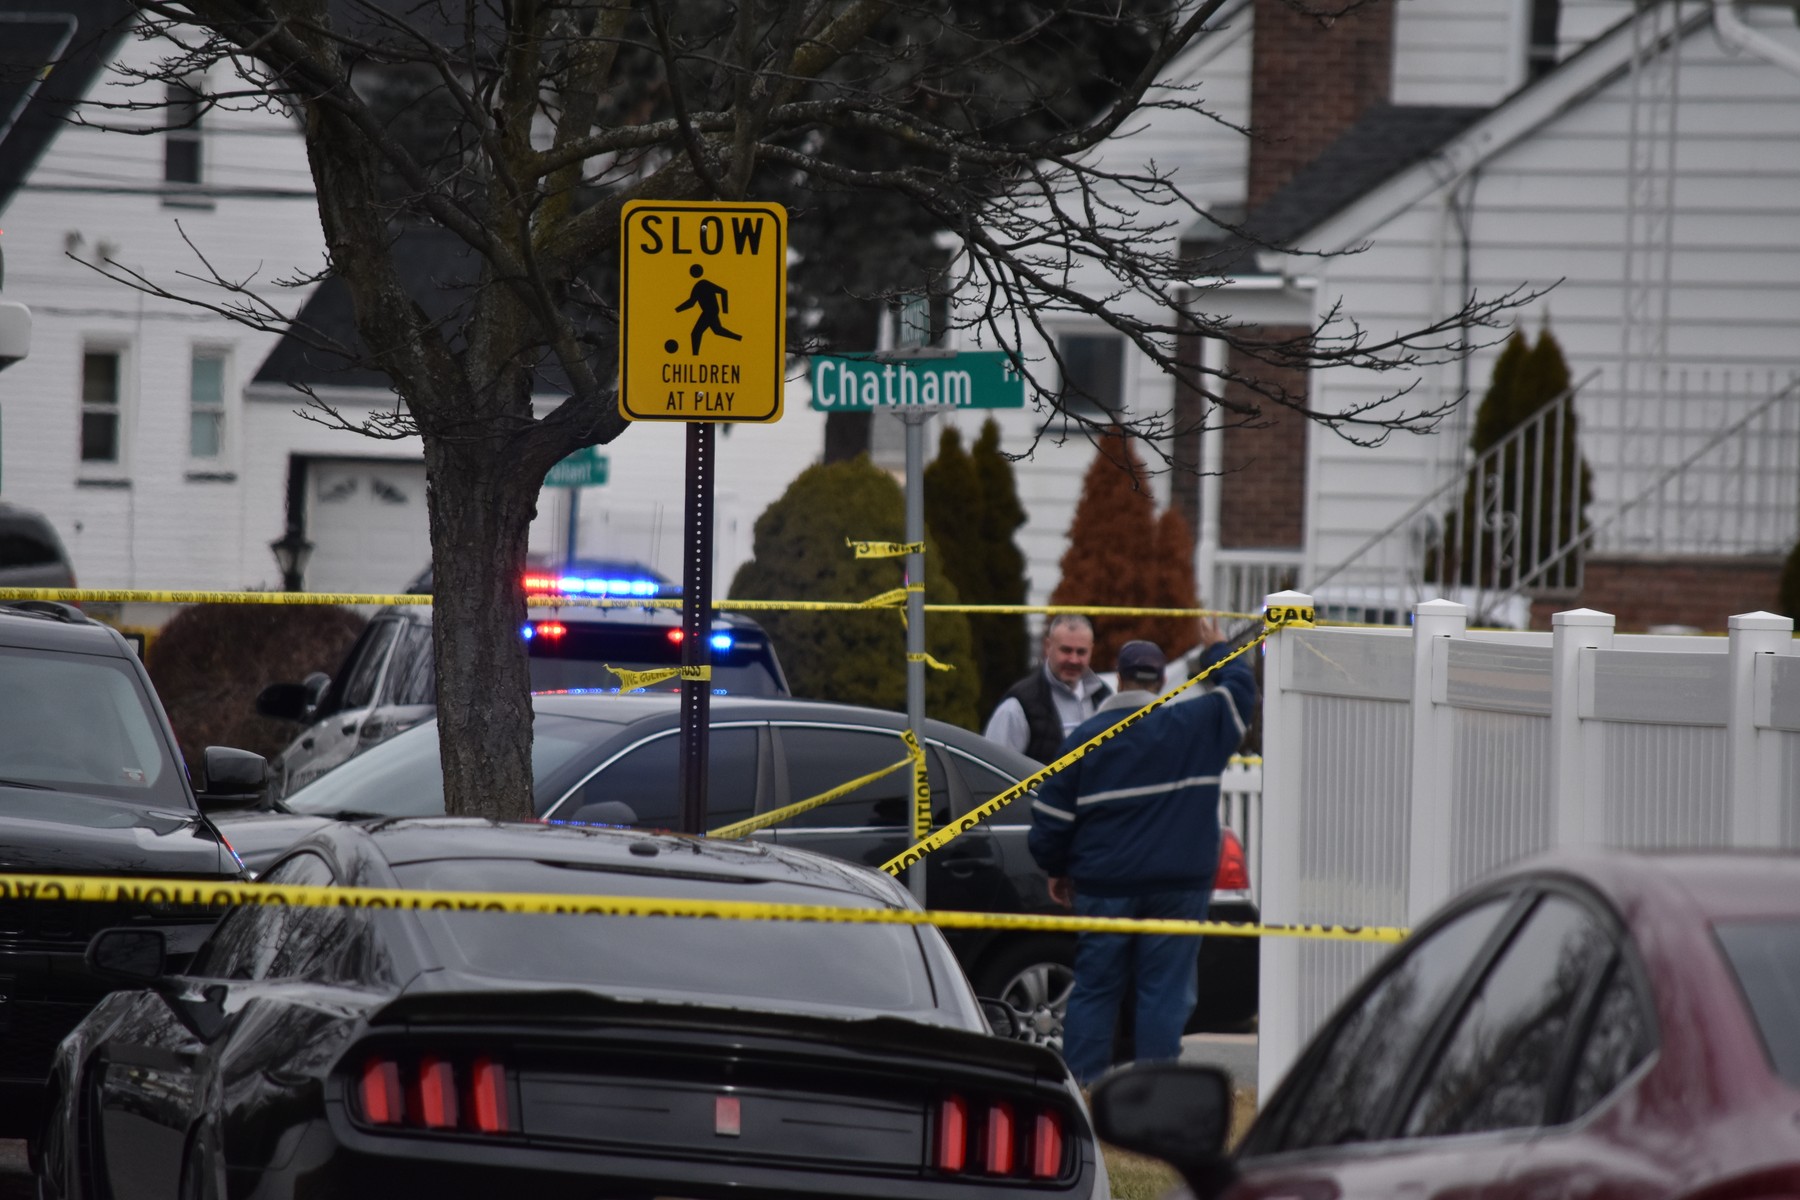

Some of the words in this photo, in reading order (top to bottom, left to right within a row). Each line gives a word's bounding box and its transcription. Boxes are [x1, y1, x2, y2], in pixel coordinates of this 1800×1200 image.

[640, 215, 764, 255] SLOW
[662, 364, 741, 384] CHILDREN
[816, 360, 972, 406] Chatham
[666, 392, 684, 411] AT
[694, 392, 735, 411] PLAY
